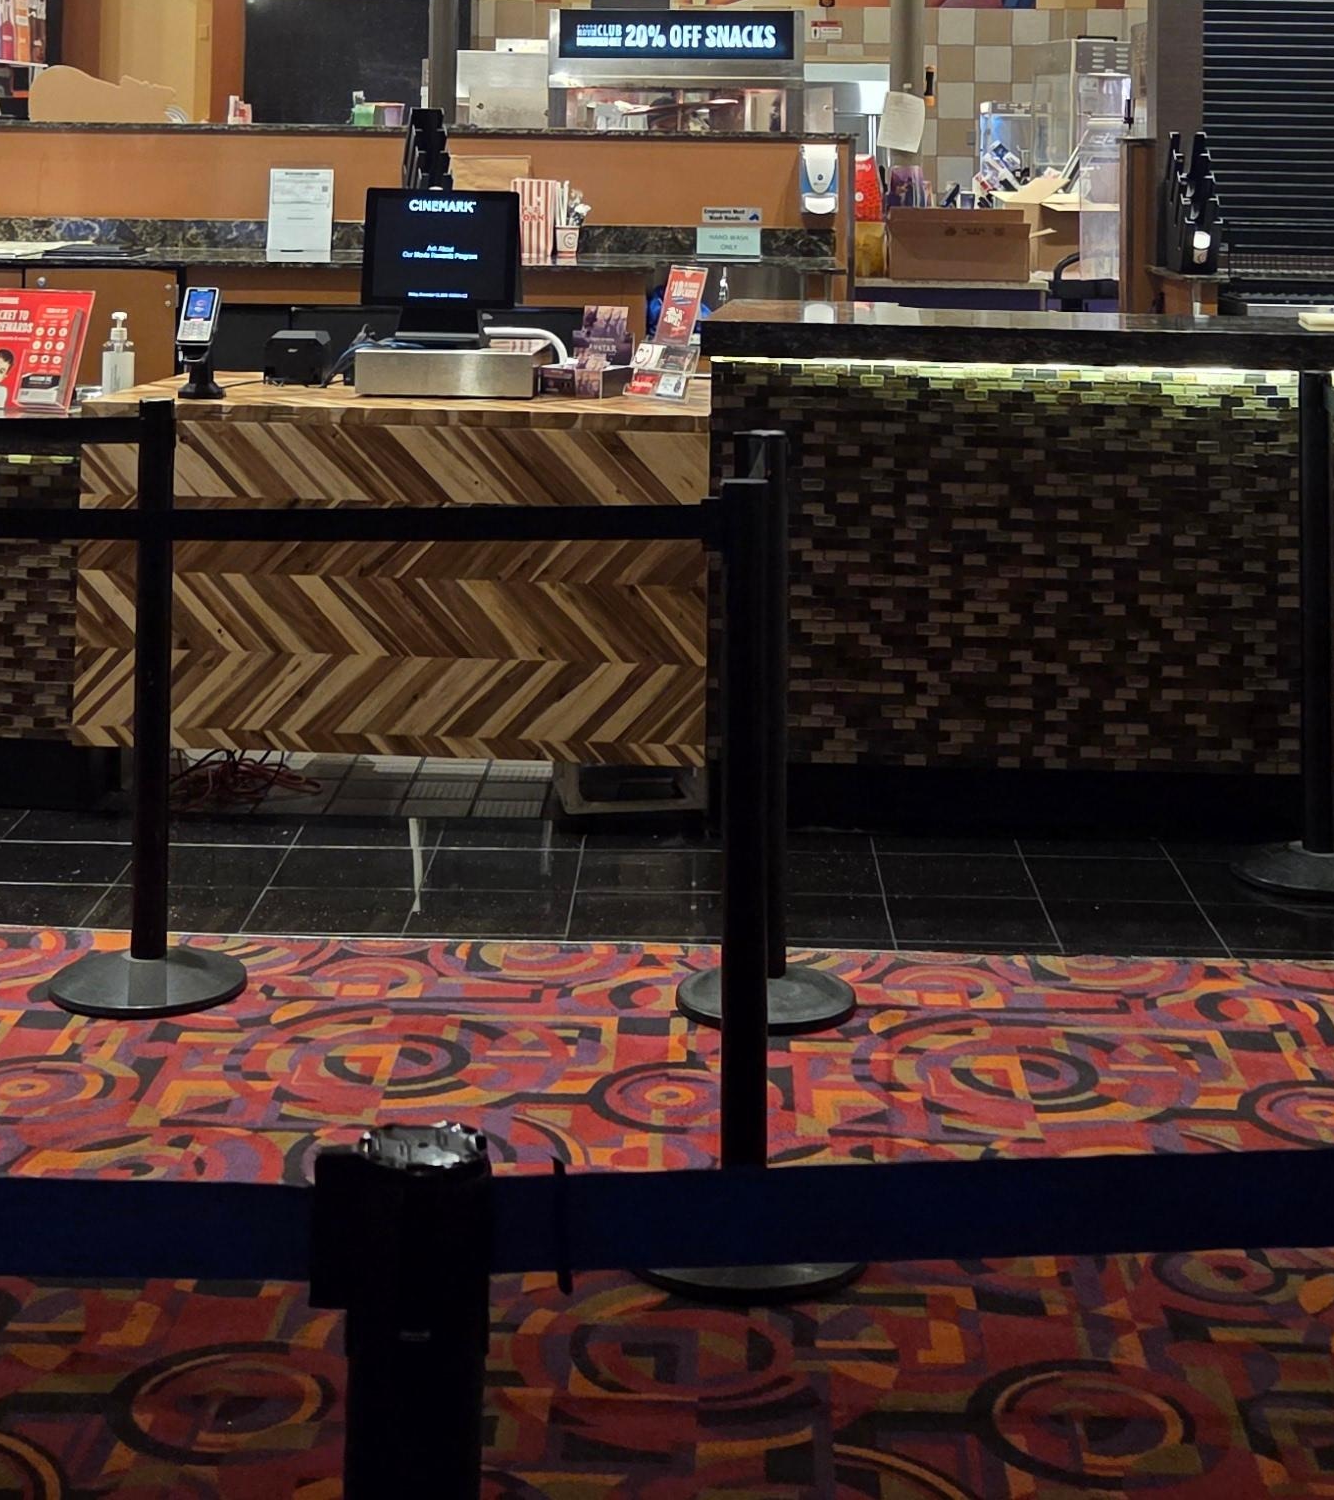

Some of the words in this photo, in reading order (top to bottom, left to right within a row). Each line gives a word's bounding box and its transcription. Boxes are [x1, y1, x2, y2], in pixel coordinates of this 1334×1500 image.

[598, 24, 622, 36] CLUB
[625, 24, 666, 48] 20%
[670, 25, 701, 48] OFF
[705, 25, 776, 49] SNACKS
[408, 199, 478, 214] CINEMARK
[521, 214, 544, 222] ORN
[19, 310, 29, 320] TO
